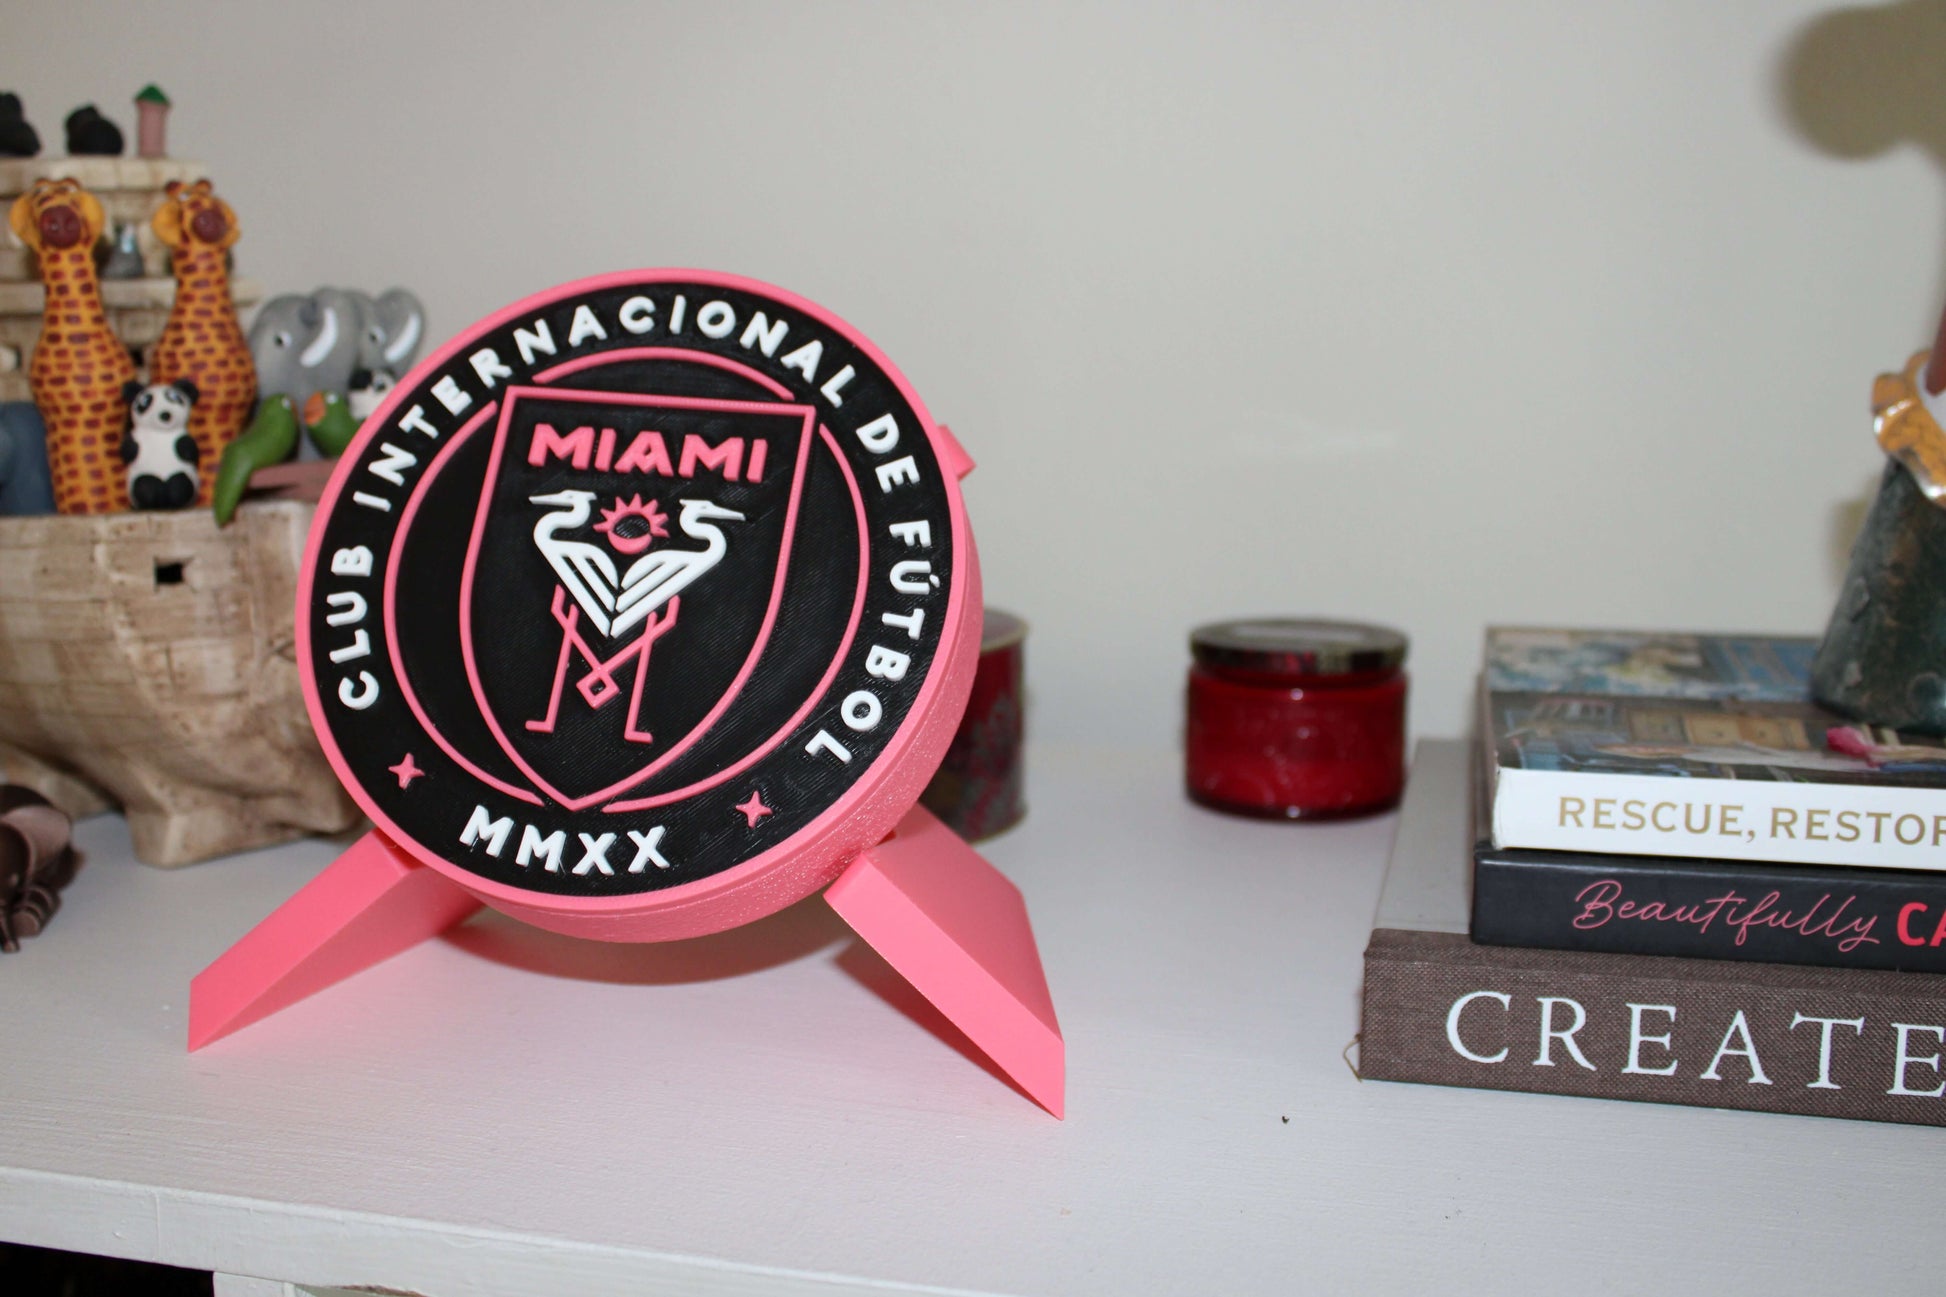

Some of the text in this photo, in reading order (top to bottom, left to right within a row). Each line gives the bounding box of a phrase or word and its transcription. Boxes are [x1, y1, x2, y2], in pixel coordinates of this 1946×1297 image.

[527, 423, 768, 483] MIAMI
[327, 295, 940, 766] CLUB INTERNACIONAL DE FÚTBOL
[459, 804, 669, 875] MMXX
[1557, 796, 1757, 843] RESCUE,
[1572, 880, 1880, 952] Beautifully
[1445, 991, 1946, 1098] CREATE
